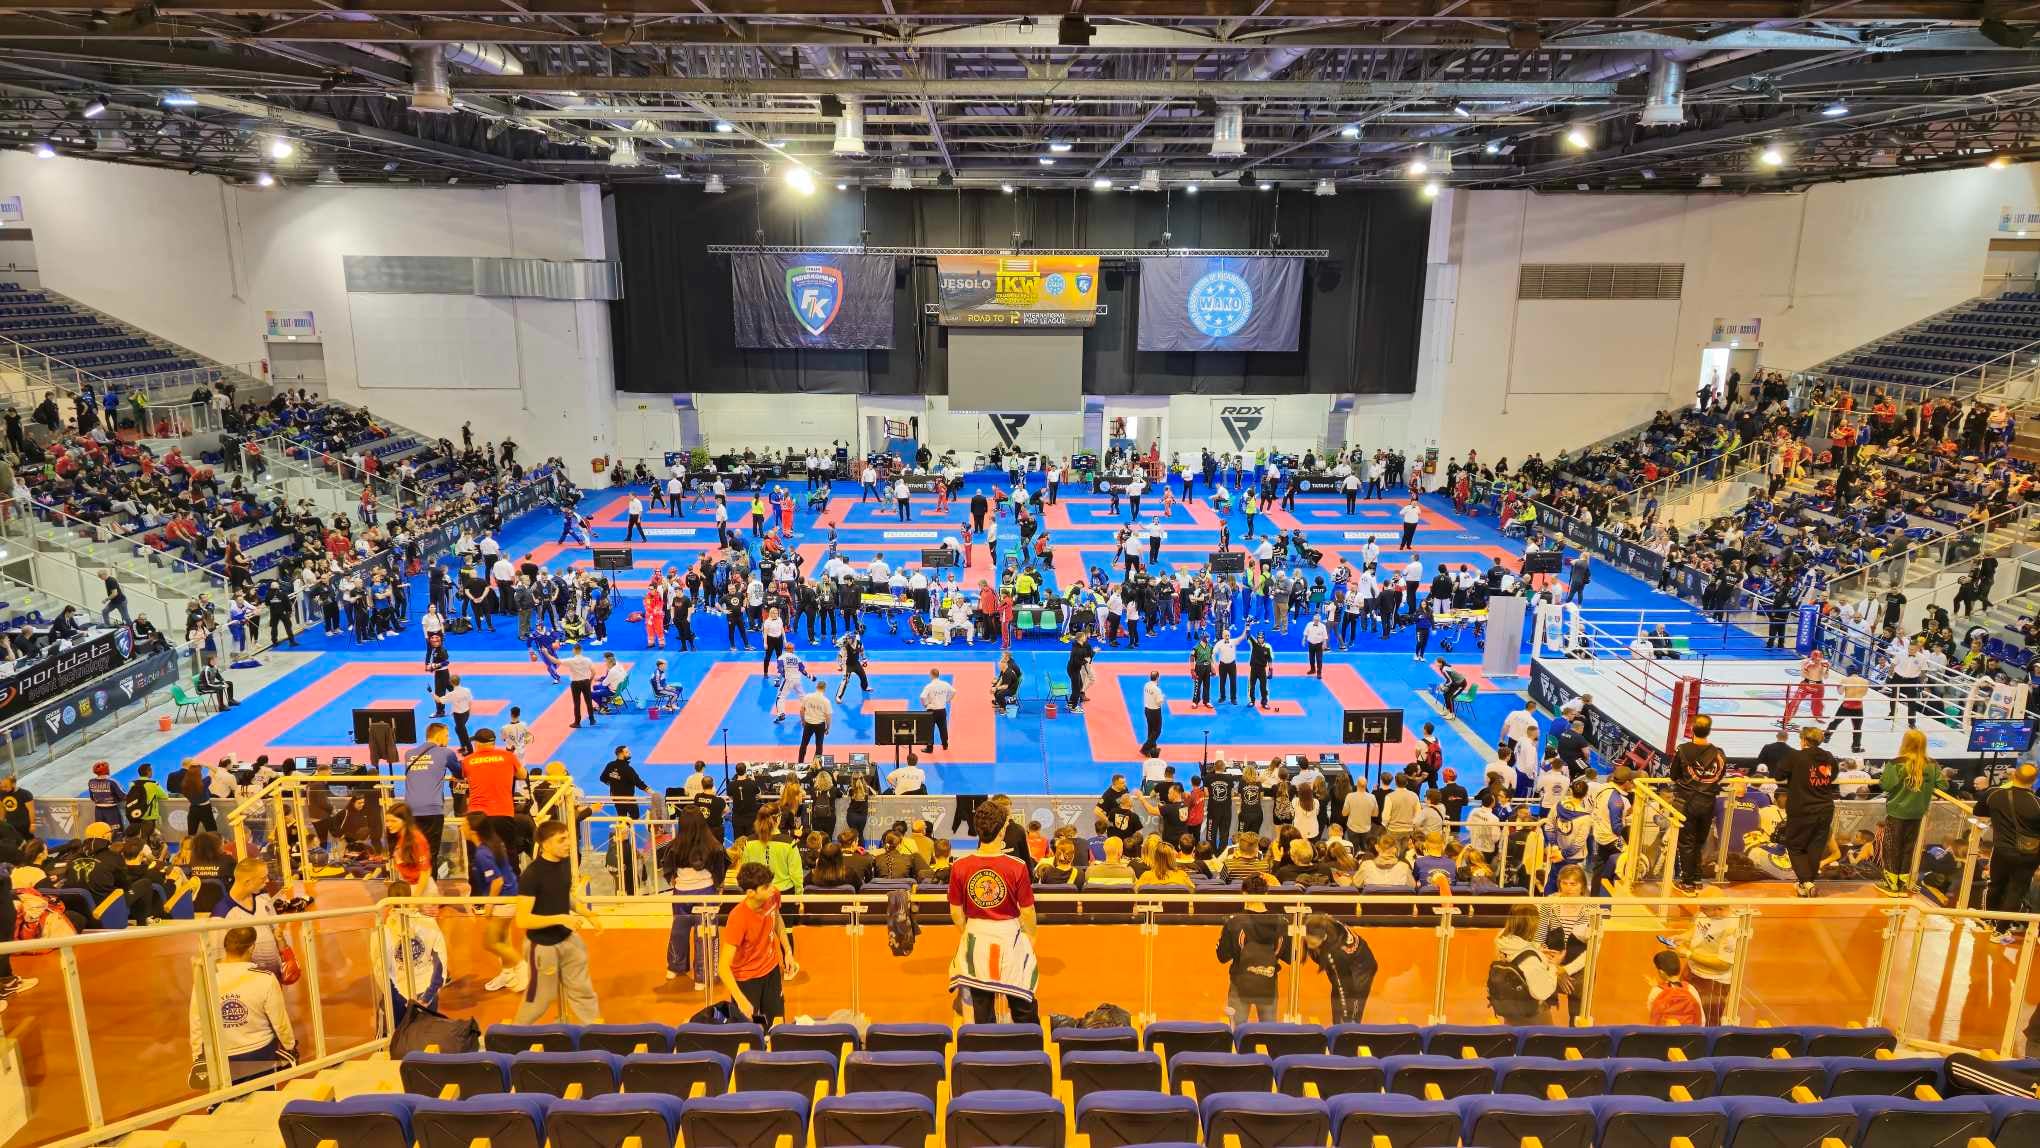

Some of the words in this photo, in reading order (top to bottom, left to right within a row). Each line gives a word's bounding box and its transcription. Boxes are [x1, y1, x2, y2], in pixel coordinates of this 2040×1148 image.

[941, 279, 991, 289] JESOLO
[1199, 296, 1242, 311] WAKO
[968, 314, 990, 322] ROAD
[993, 314, 1005, 322] TO
[1221, 407, 1265, 415] RDX
